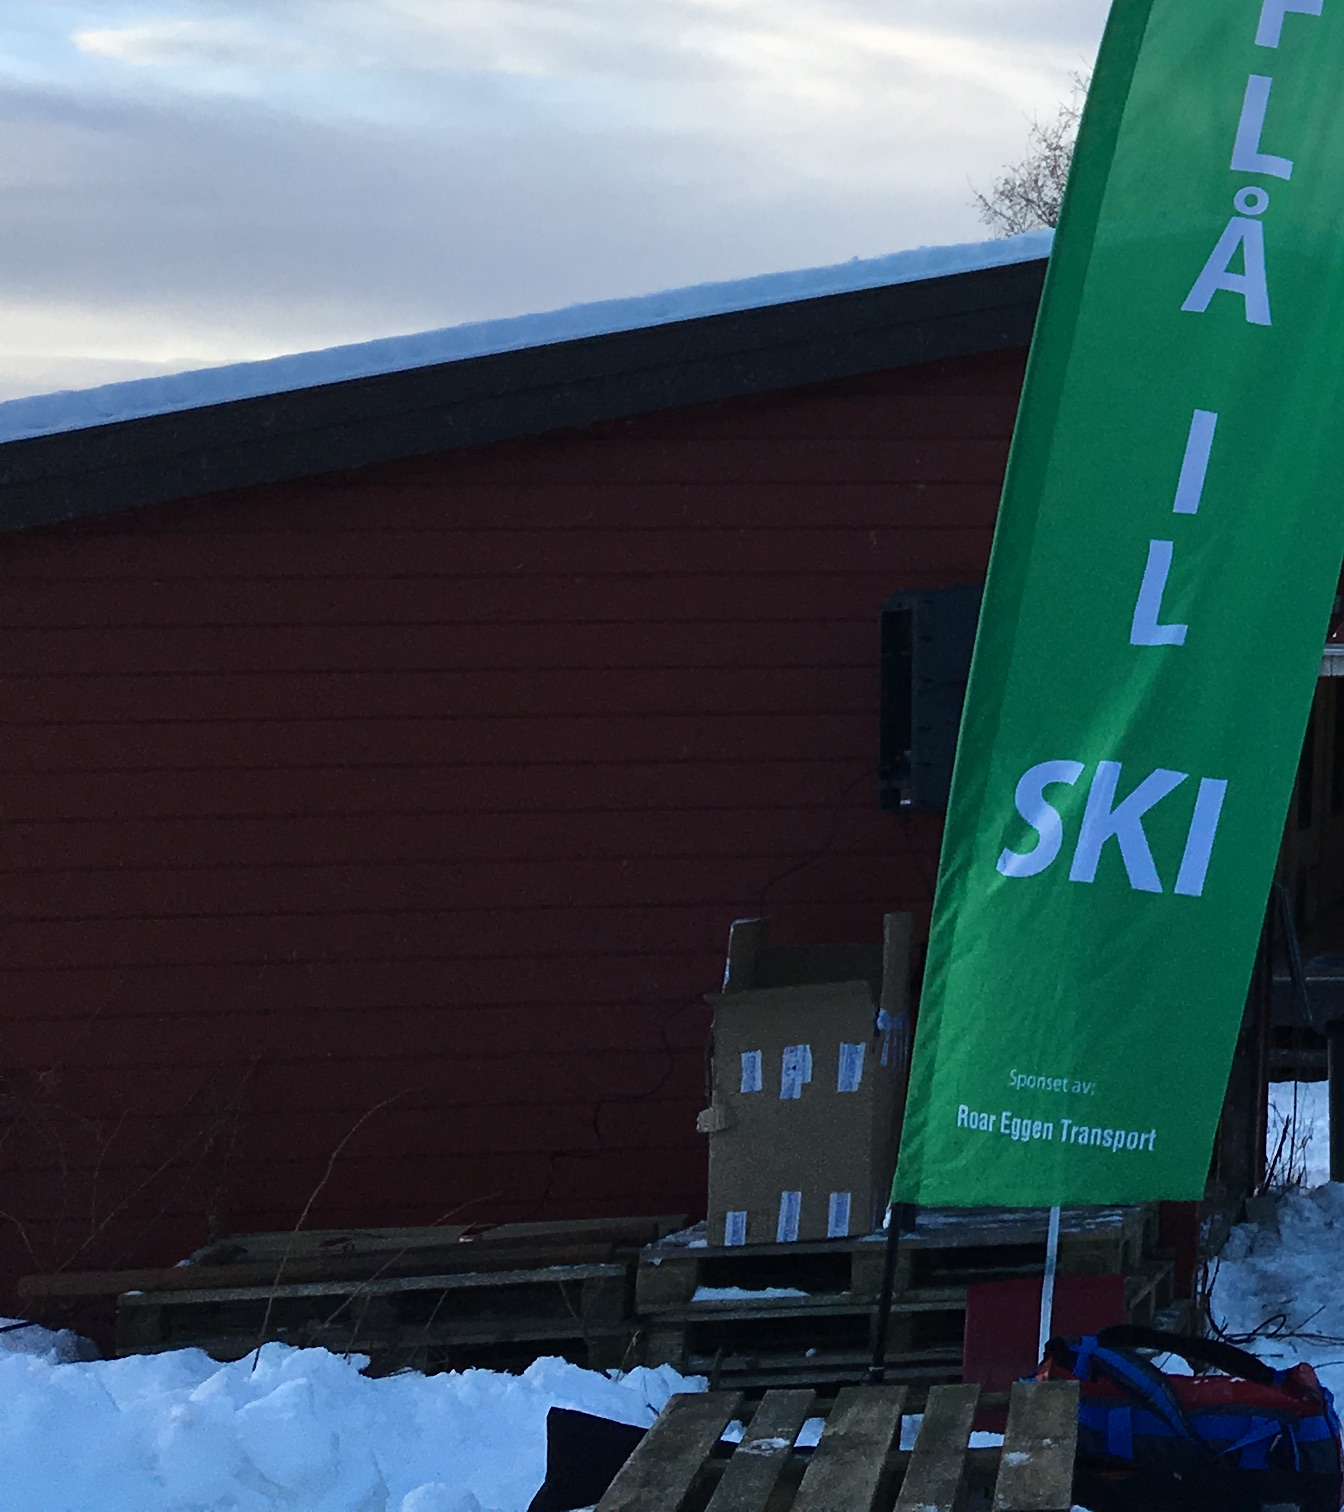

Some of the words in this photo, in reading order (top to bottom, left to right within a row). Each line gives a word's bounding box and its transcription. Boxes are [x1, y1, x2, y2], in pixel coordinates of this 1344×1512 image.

[996, 760, 1229, 897] SKI
[1008, 1068, 1069, 1090] Sponset
[957, 1104, 996, 1132] Roar
[1000, 1111, 1053, 1142] Eggen
[1060, 1119, 1157, 1152] Transport
